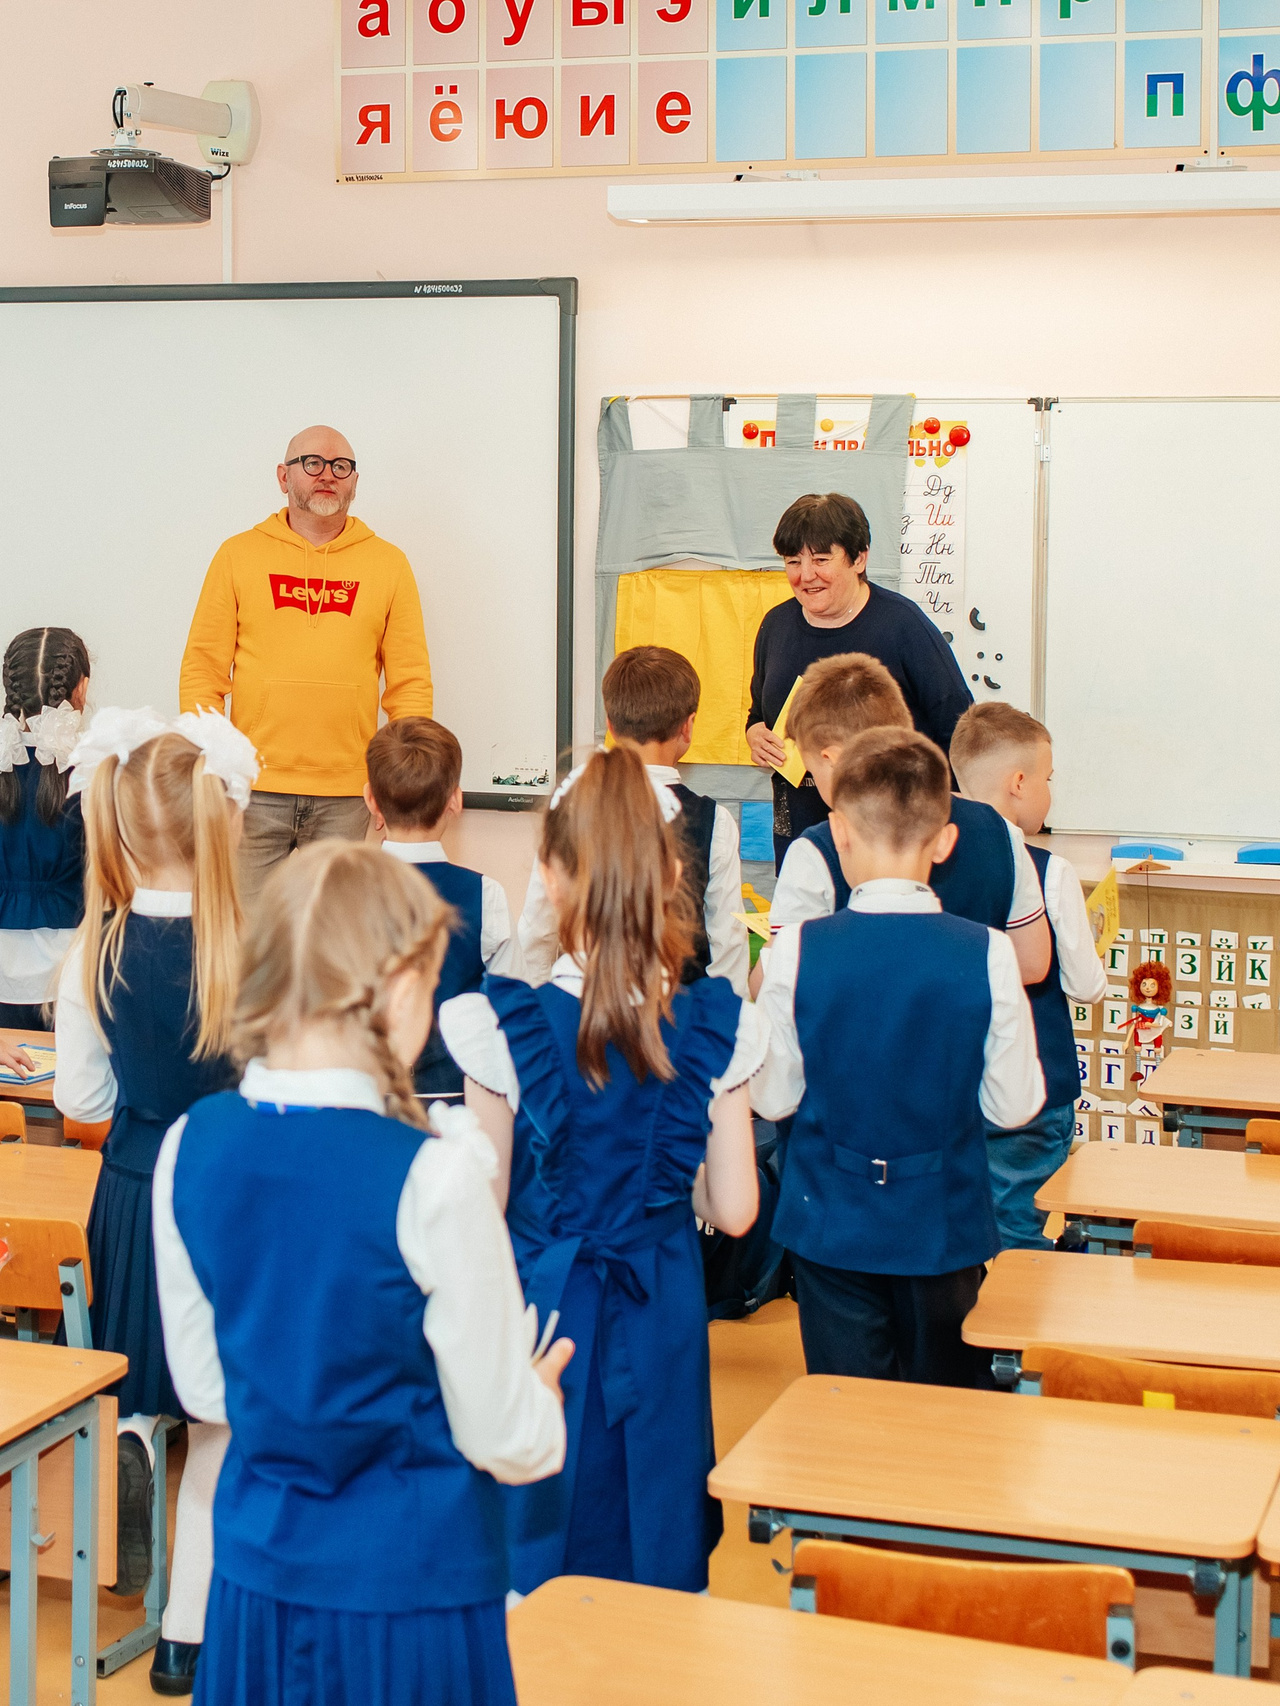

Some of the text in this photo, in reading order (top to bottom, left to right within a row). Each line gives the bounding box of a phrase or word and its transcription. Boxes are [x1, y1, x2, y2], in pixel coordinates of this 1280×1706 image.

[355, 54, 1280, 146] я ё ю и е п ф
